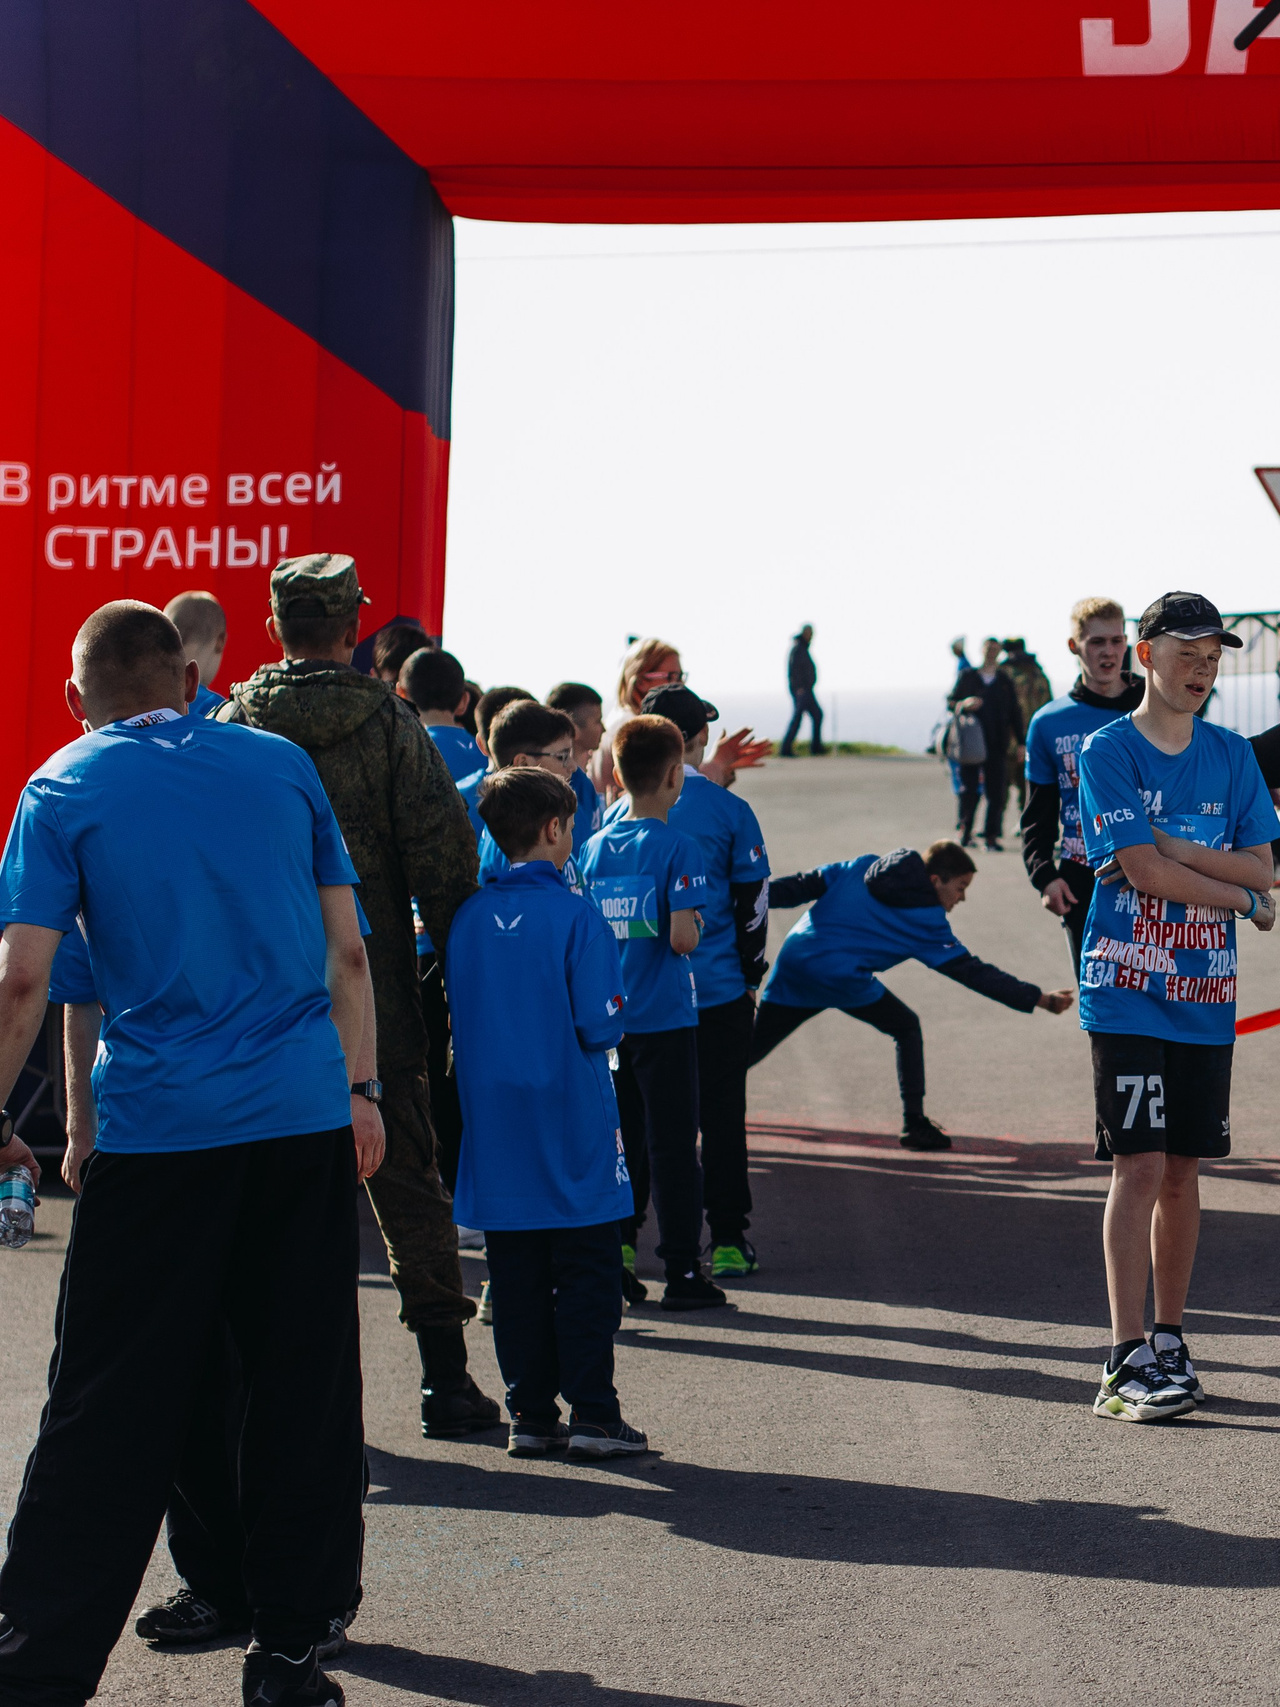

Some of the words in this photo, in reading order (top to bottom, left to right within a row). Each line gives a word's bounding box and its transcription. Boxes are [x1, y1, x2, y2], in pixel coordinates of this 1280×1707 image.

[0, 463, 30, 504] В
[48, 472, 209, 513] ритме
[226, 461, 343, 505] всей
[45, 524, 289, 569] СТРАНЫ!
[1102, 808, 1135, 826] ПСБ
[601, 897, 638, 919] 10037
[1085, 961, 1150, 993] #ЗАБЕГ
[1116, 1075, 1166, 1129] 72
